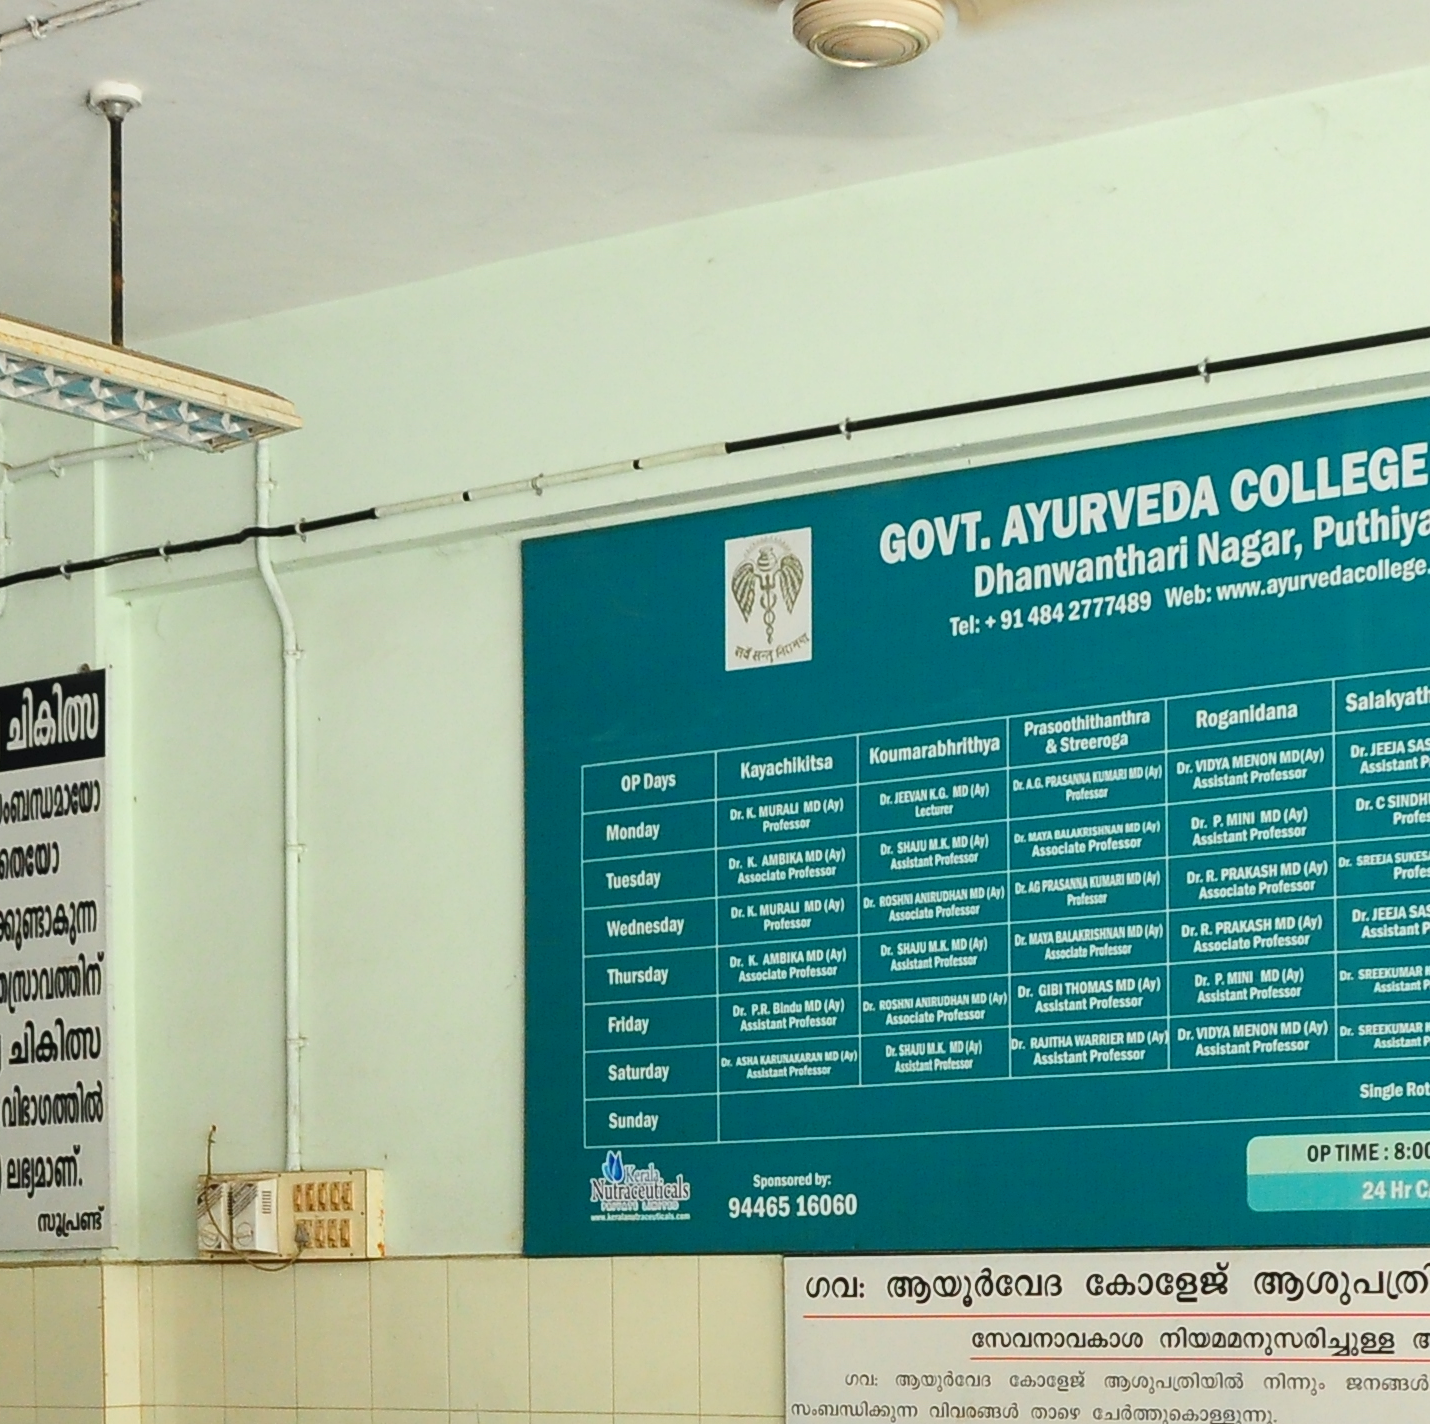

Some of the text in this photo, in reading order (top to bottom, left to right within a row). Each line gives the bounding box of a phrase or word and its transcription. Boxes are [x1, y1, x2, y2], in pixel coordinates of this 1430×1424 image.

[879, 510, 991, 565] GOVT.
[1001, 474, 1220, 548] AYURVEDA
[1230, 441, 1429, 513] COLLEGE
[974, 535, 1188, 598] Dhanwanthari
[1197, 527, 1303, 568] Nagar,
[949, 614, 980, 637] Tel:
[1000, 608, 1024, 630] 91
[1027, 602, 1065, 626] 484
[1068, 590, 1152, 622] 2777489
[1164, 583, 1212, 608] Web:
[1024, 709, 1151, 737] Prasoothithanthra
[1195, 702, 1298, 730] Roganidana
[869, 735, 1001, 765] Koumarabhrithya
[1045, 732, 1129, 755] & Streeroga
[1350, 744, 1369, 759] Dr.
[1369, 740, 1406, 757] JEEJA
[740, 754, 834, 781] Kayachikitsa
[1176, 761, 1194, 775] Dr.
[1194, 756, 1231, 773] VIDYA
[1231, 751, 1278, 769] MENON
[1359, 756, 1419, 775] Assistant
[620, 772, 677, 792] OP Days
[1192, 767, 1308, 790] Assistant Professor
[606, 821, 661, 842] Monday
[605, 869, 662, 890] Tuesday
[606, 916, 685, 938] Wednesday
[606, 965, 669, 986] Thursday
[607, 1015, 650, 1035] Friday
[608, 1062, 670, 1083] Saturday
[1359, 1082, 1404, 1101] Single
[608, 1111, 659, 1132] Sunday
[1307, 1144, 1332, 1163] OP
[1334, 1142, 1380, 1162] TIME
[591, 1173, 690, 1201] Nutraceuticals
[752, 1172, 832, 1191] Sponsored by:
[1361, 1180, 1387, 1201] 24
[1390, 1180, 1413, 1199] Hr
[728, 1193, 858, 1219] 94465 16060
